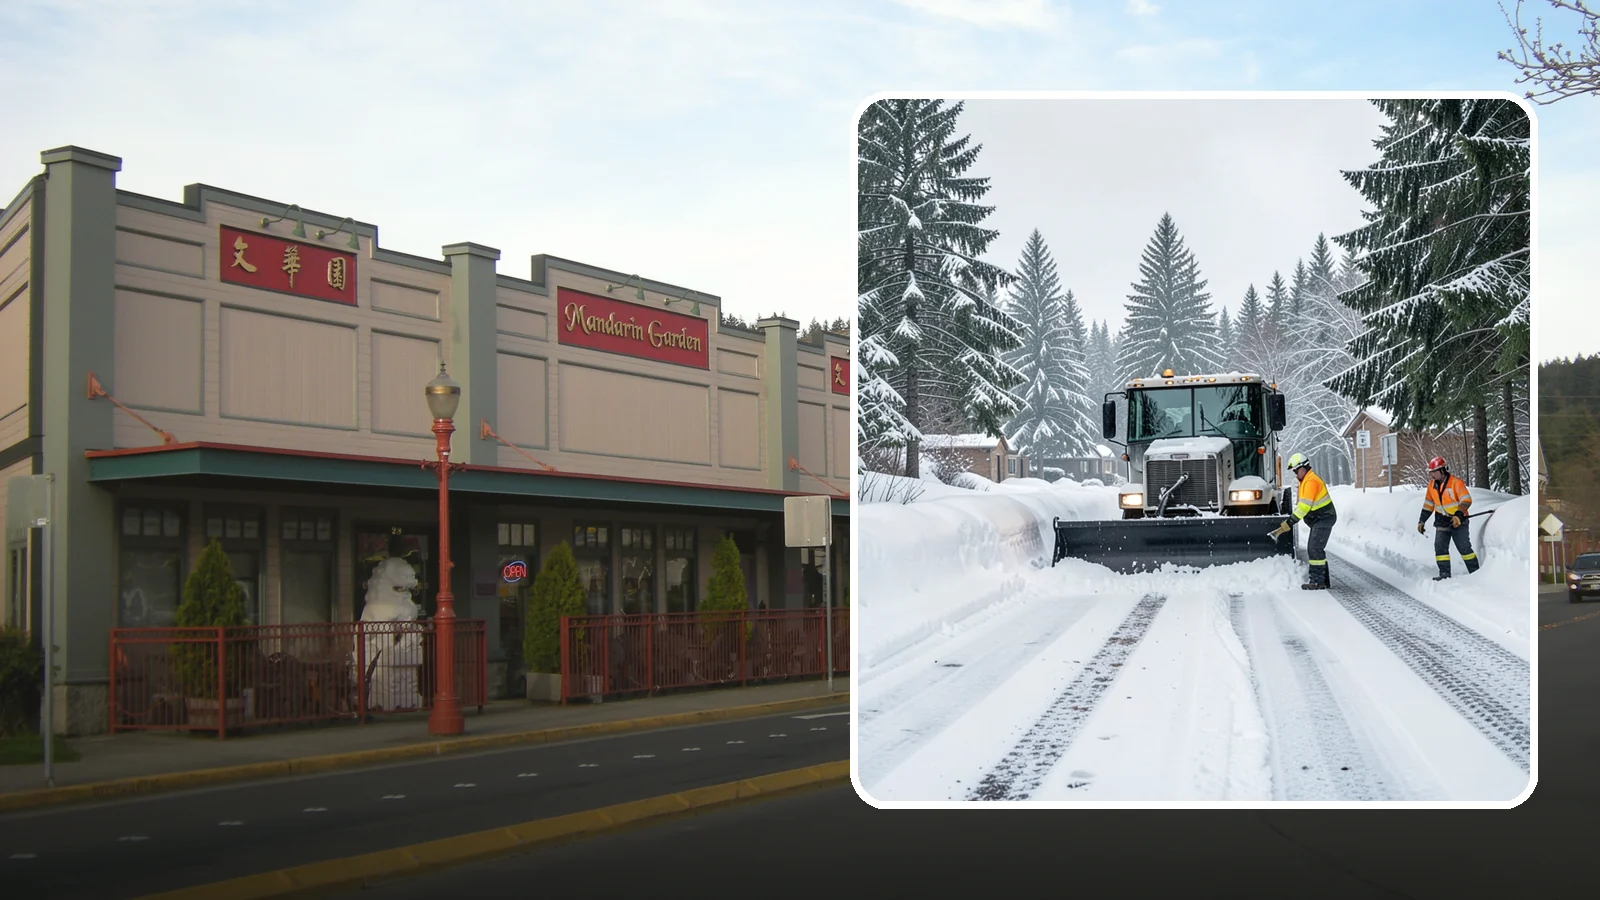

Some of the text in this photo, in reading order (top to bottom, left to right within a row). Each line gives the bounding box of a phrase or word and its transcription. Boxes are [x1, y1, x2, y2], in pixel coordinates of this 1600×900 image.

[231, 236, 346, 290] 文華園
[564, 302, 701, 352] Mandarin Garden
[503, 565, 527, 578] OPEN
